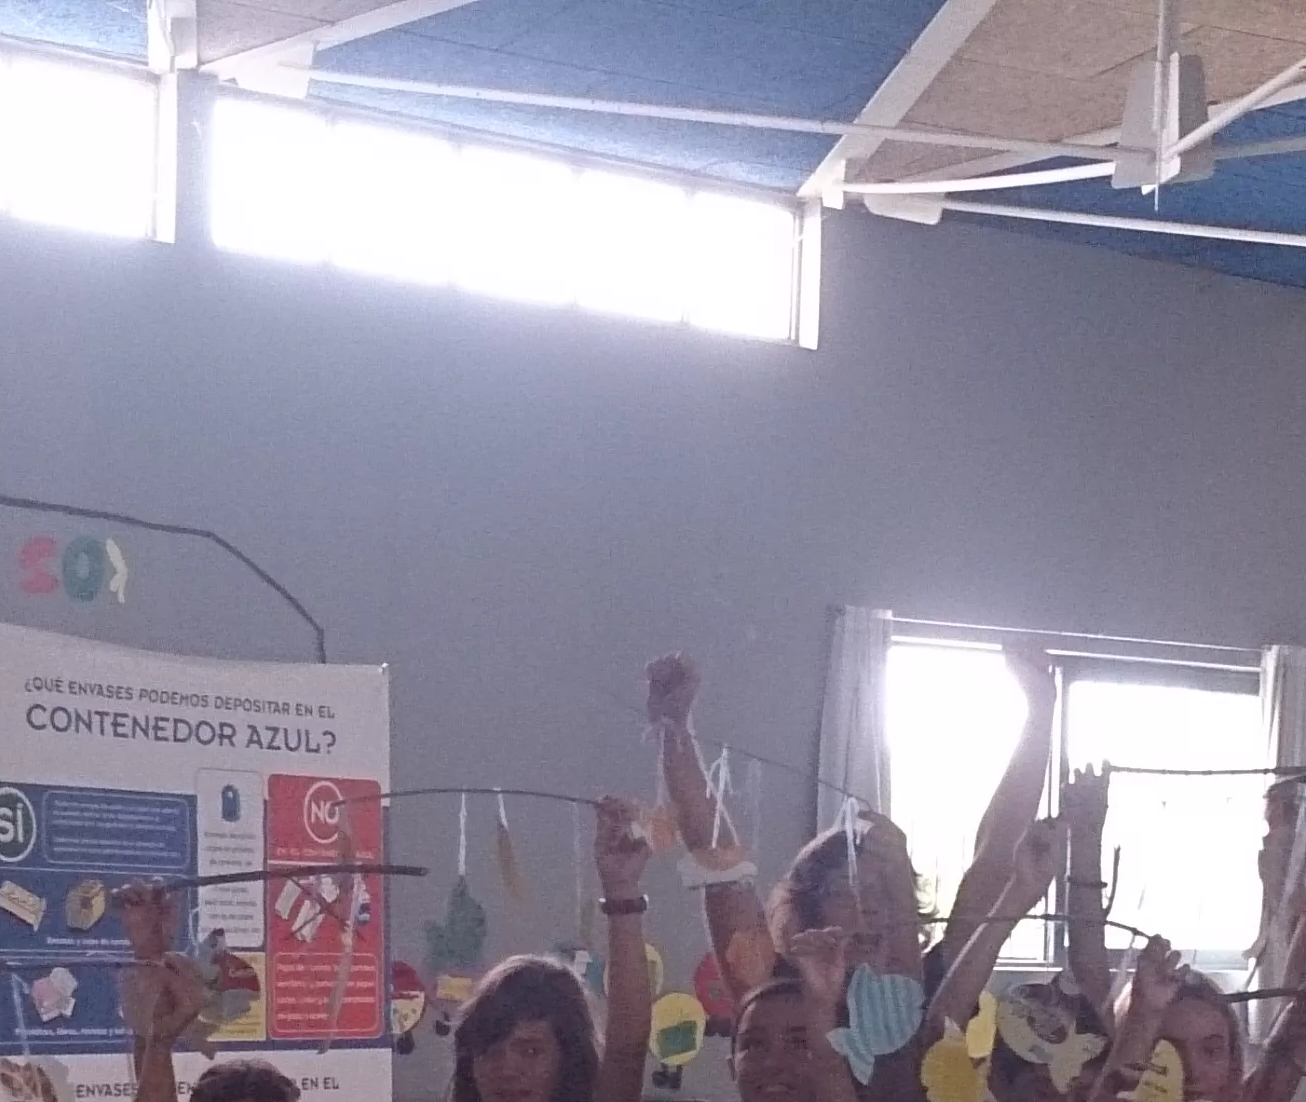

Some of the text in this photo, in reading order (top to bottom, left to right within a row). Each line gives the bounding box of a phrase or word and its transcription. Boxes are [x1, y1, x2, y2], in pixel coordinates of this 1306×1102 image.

[24, 675, 335, 719] ¿QUÉ ENVASES PODEMOS DEPOSITAR EN EL
[26, 703, 337, 754] CONTENEDOR AZUL?
[310, 801, 340, 824] NO
[76, 1077, 340, 1099] ENVASES EN EL
